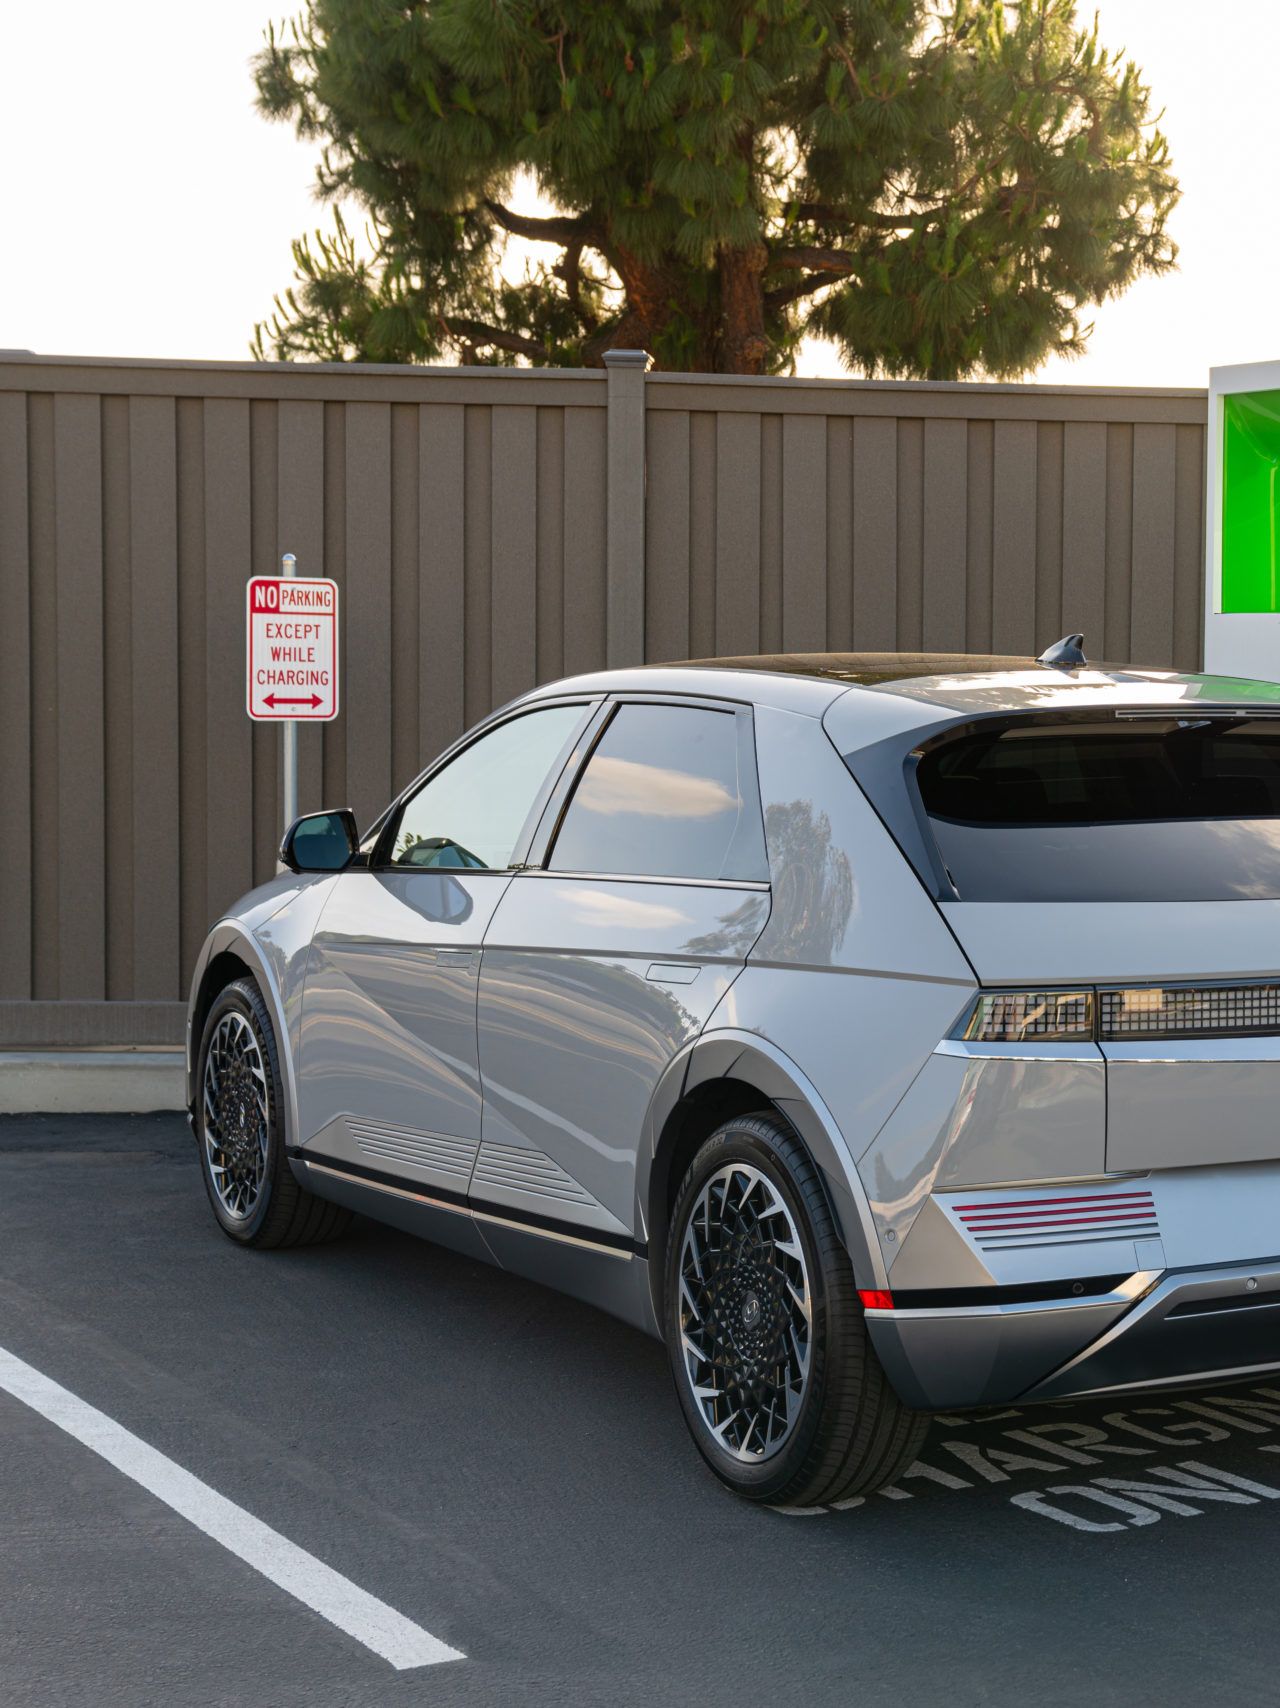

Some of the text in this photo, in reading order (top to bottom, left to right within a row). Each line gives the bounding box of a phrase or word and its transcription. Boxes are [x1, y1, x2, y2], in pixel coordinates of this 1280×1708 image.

[254, 585, 331, 609] NO PARKING
[265, 623, 321, 639] EXCEPT
[270, 646, 316, 662] WHILE
[256, 669, 329, 686] CHARGING
